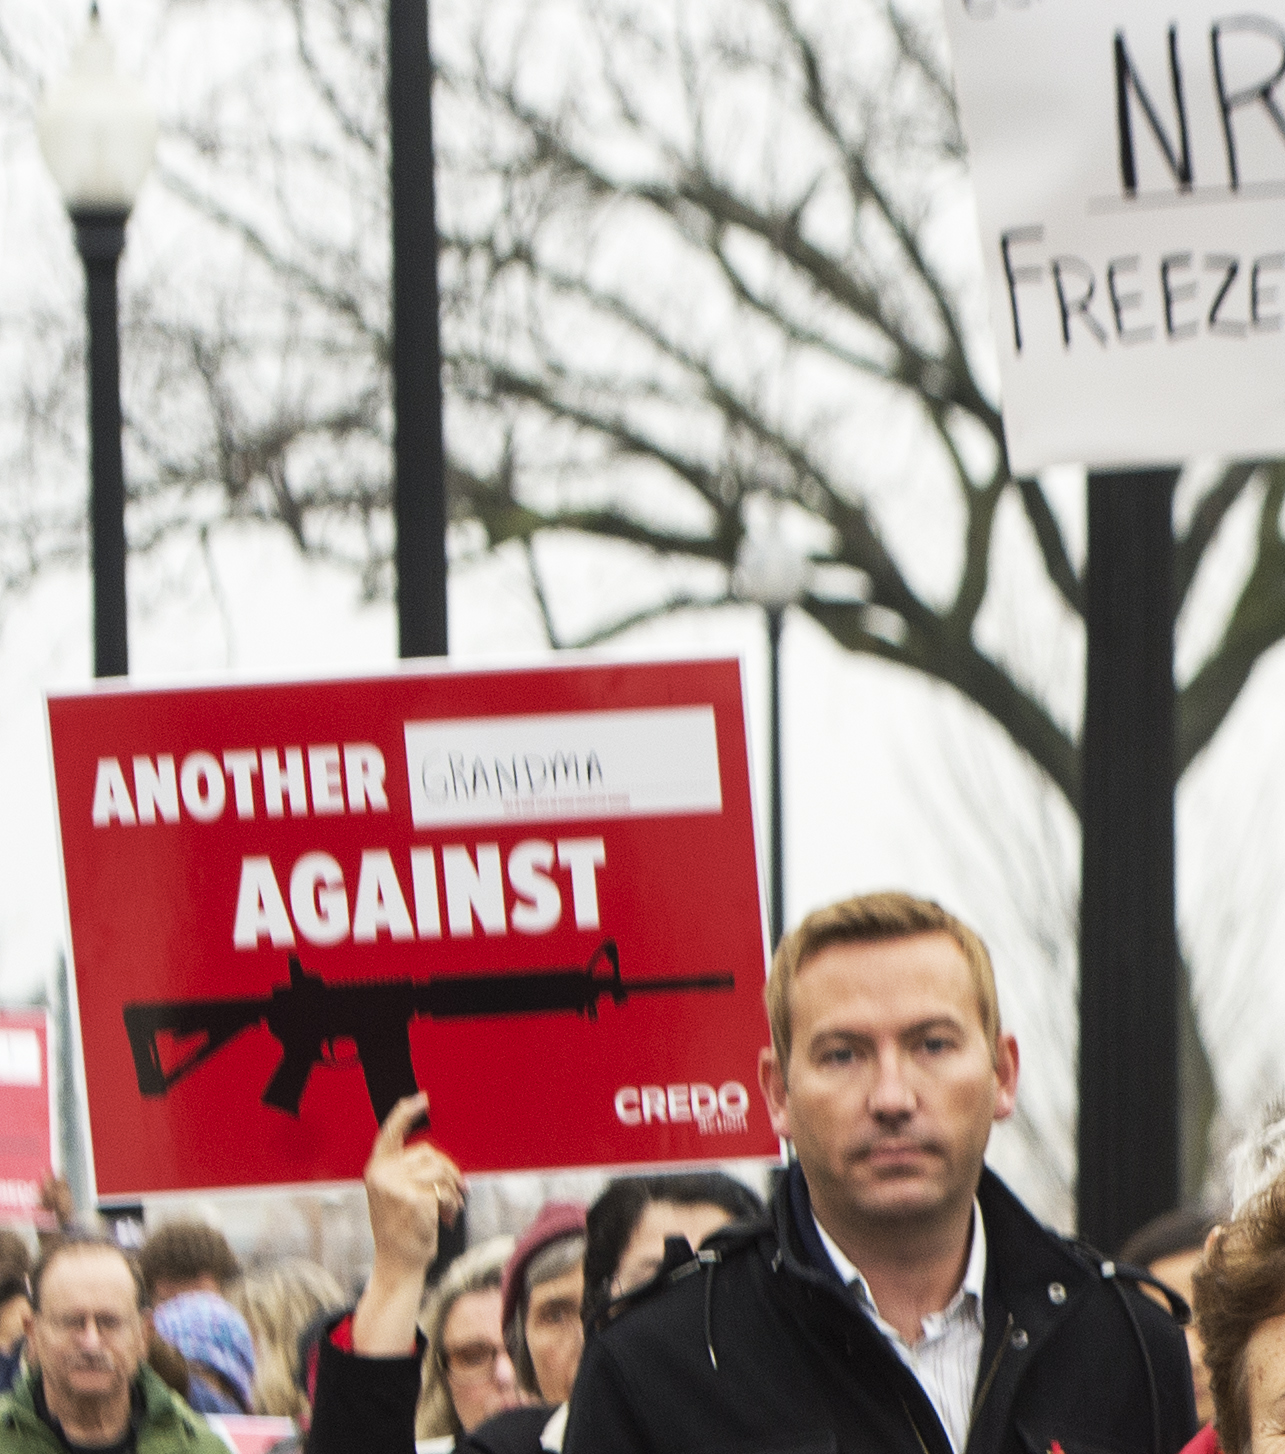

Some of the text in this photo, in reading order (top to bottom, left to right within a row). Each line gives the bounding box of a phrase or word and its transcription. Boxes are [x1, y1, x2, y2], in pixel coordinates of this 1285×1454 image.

[92, 742, 390, 827] ANOTHER
[421, 747, 605, 805] GRANDMA
[232, 836, 607, 951] AGAINST
[614, 1080, 749, 1126] CREDO
